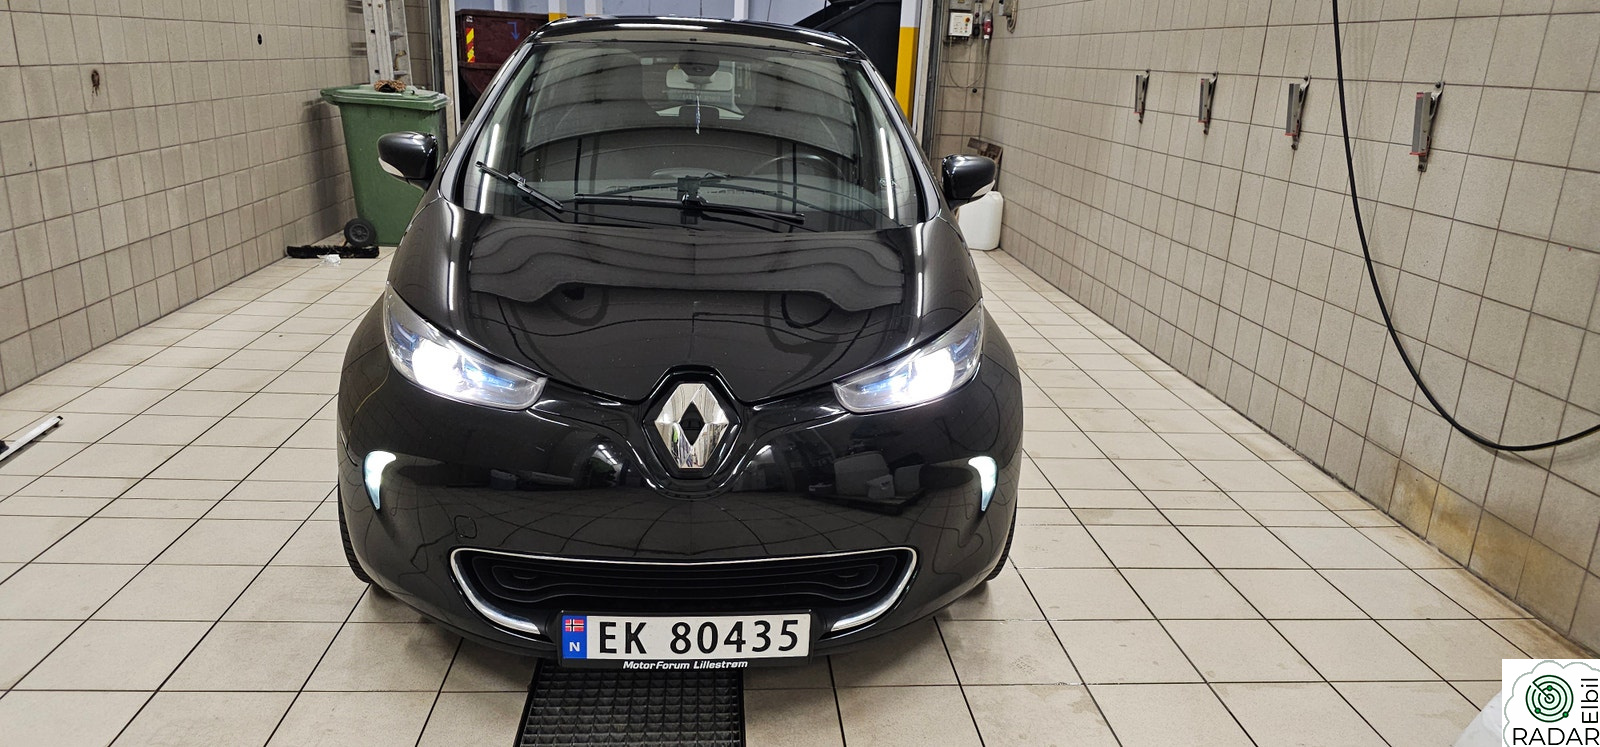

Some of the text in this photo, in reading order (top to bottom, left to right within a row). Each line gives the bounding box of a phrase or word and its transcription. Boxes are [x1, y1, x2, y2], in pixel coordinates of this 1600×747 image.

[599, 619, 799, 655] EK 80435
[569, 641, 581, 652] N
[623, 660, 748, 670] MotorForum Lillestrøm
